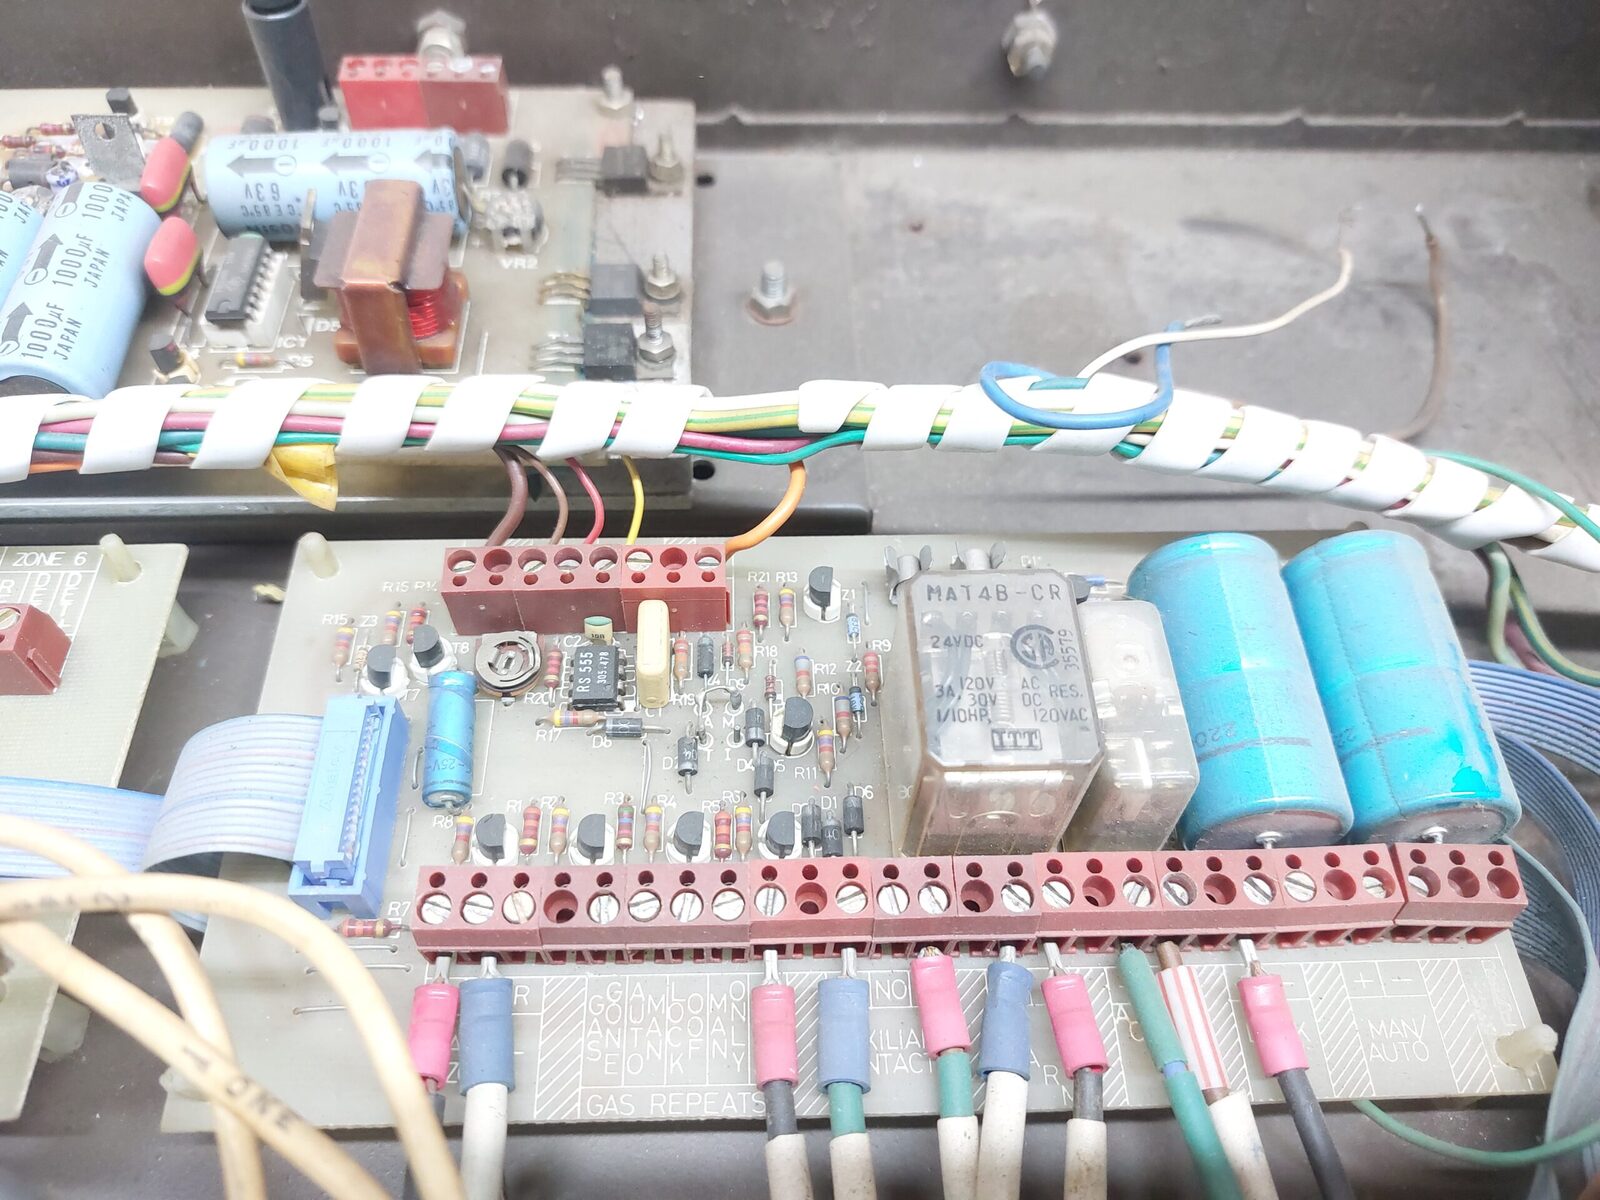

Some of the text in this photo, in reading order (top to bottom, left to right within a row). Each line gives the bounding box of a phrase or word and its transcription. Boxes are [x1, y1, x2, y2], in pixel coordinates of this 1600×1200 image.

[83, 247, 111, 289] JAPAN
[53, 316, 83, 361] JAPAN
[12, 551, 89, 567] ZONE 6
[748, 571, 798, 583] R21 R13
[926, 583, 1062, 602] MAT4B-CR
[360, 614, 379, 627] Z3
[562, 634, 583, 649] C2
[872, 639, 892, 653] R9
[930, 634, 985, 650] 24VDC
[755, 646, 778, 658] R18
[576, 651, 594, 693] RS 555
[813, 663, 837, 676] R12
[960, 677, 995, 691] 120V
[1021, 676, 1041, 690] AC
[1049, 684, 1084, 699] RES.
[969, 693, 998, 707] 30V
[1022, 693, 1042, 707] DC
[1032, 707, 1089, 723] 120VAC
[535, 727, 562, 742] R17
[793, 765, 818, 780] R11
[603, 790, 625, 806] R3
[820, 795, 838, 810] D1
[387, 900, 412, 917] R7
[875, 978, 908, 1001] NO
[1369, 1040, 1431, 1063] AUTO
[586, 1091, 766, 1117] GAS REPEATS
